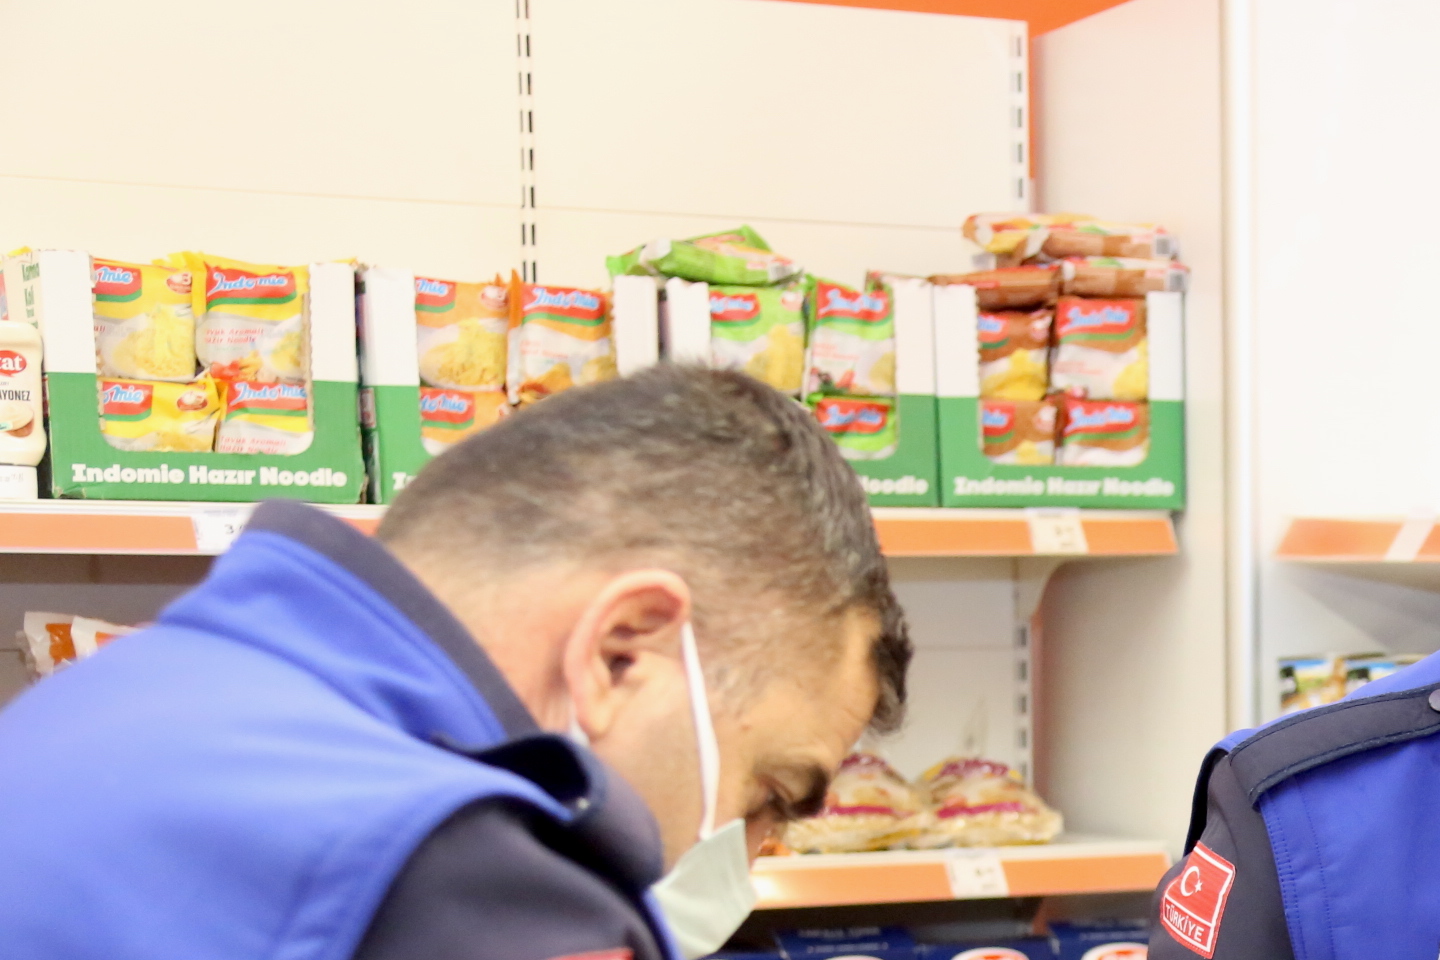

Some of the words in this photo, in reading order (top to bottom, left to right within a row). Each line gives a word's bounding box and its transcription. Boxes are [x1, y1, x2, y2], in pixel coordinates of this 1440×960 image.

[0, 390, 31, 402] AYONEZ
[72, 463, 184, 484] Indomie
[189, 466, 256, 486] Hazır
[260, 466, 347, 487] Noodle
[954, 477, 1044, 496] Indomie
[1103, 478, 1175, 497] Noodle
[1165, 903, 1205, 943] TÜRKİYE
